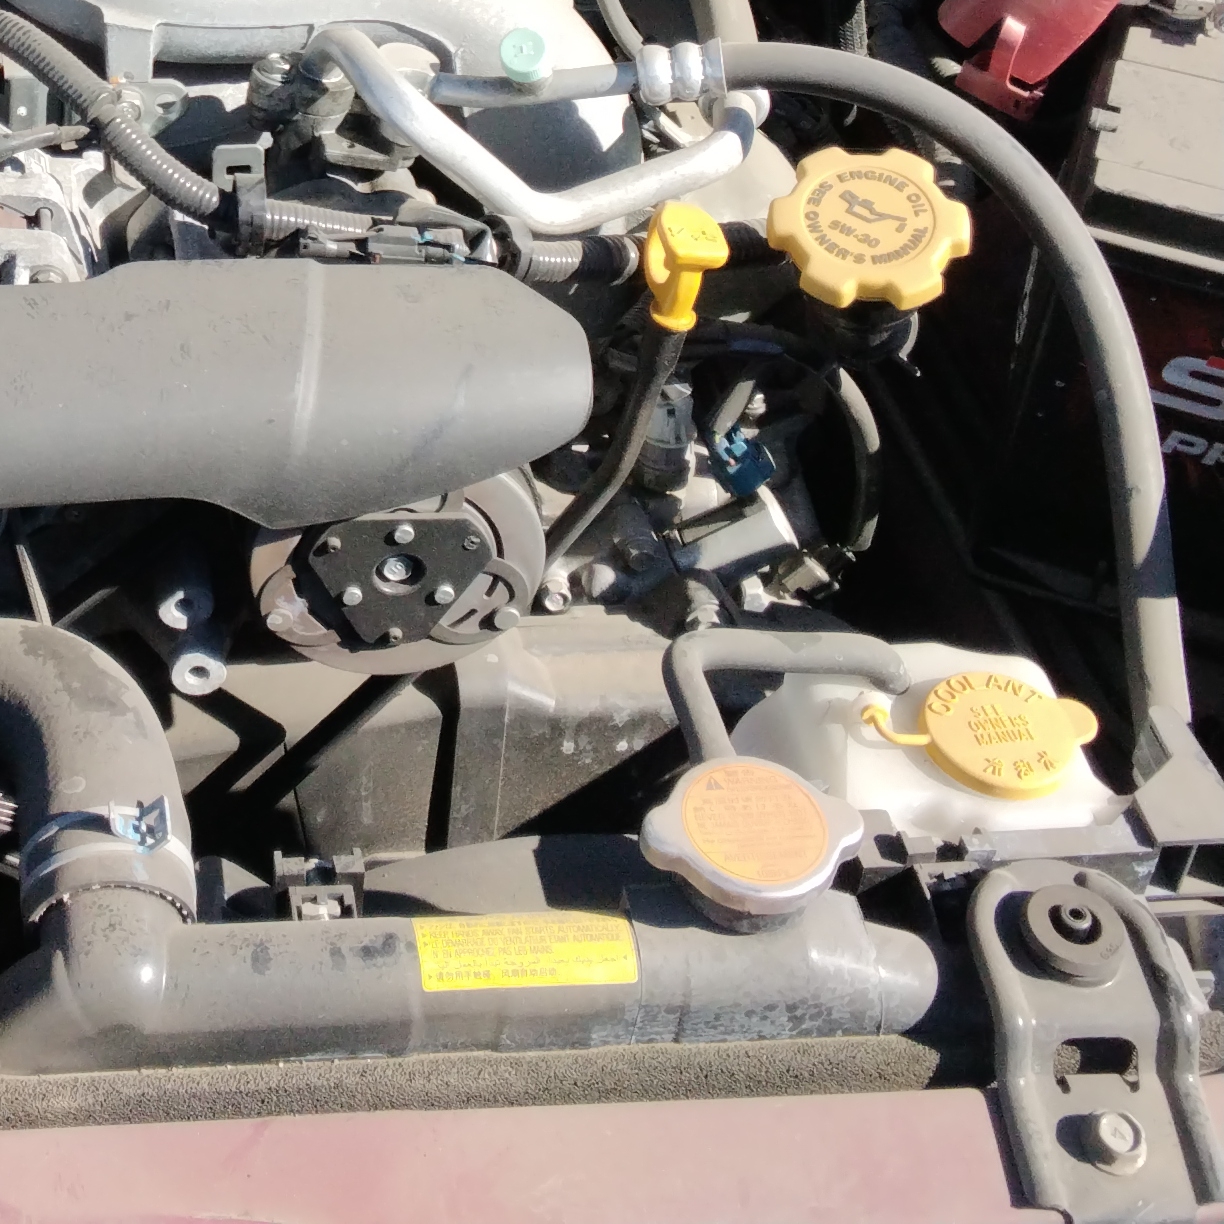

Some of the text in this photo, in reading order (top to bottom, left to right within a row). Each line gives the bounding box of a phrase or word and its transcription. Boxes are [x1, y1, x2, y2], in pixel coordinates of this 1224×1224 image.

[836, 169, 929, 218] ENGINE OIL
[804, 180, 929, 266] SEE OWNER'S MANUAL
[827, 219, 881, 249] 5W-30
[926, 673, 1044, 717] COOLANT
[967, 713, 1031, 734] OWNERS
[969, 703, 1003, 719] SEE
[973, 727, 1036, 747] MANUAL
[429, 930, 448, 940] KEEP
